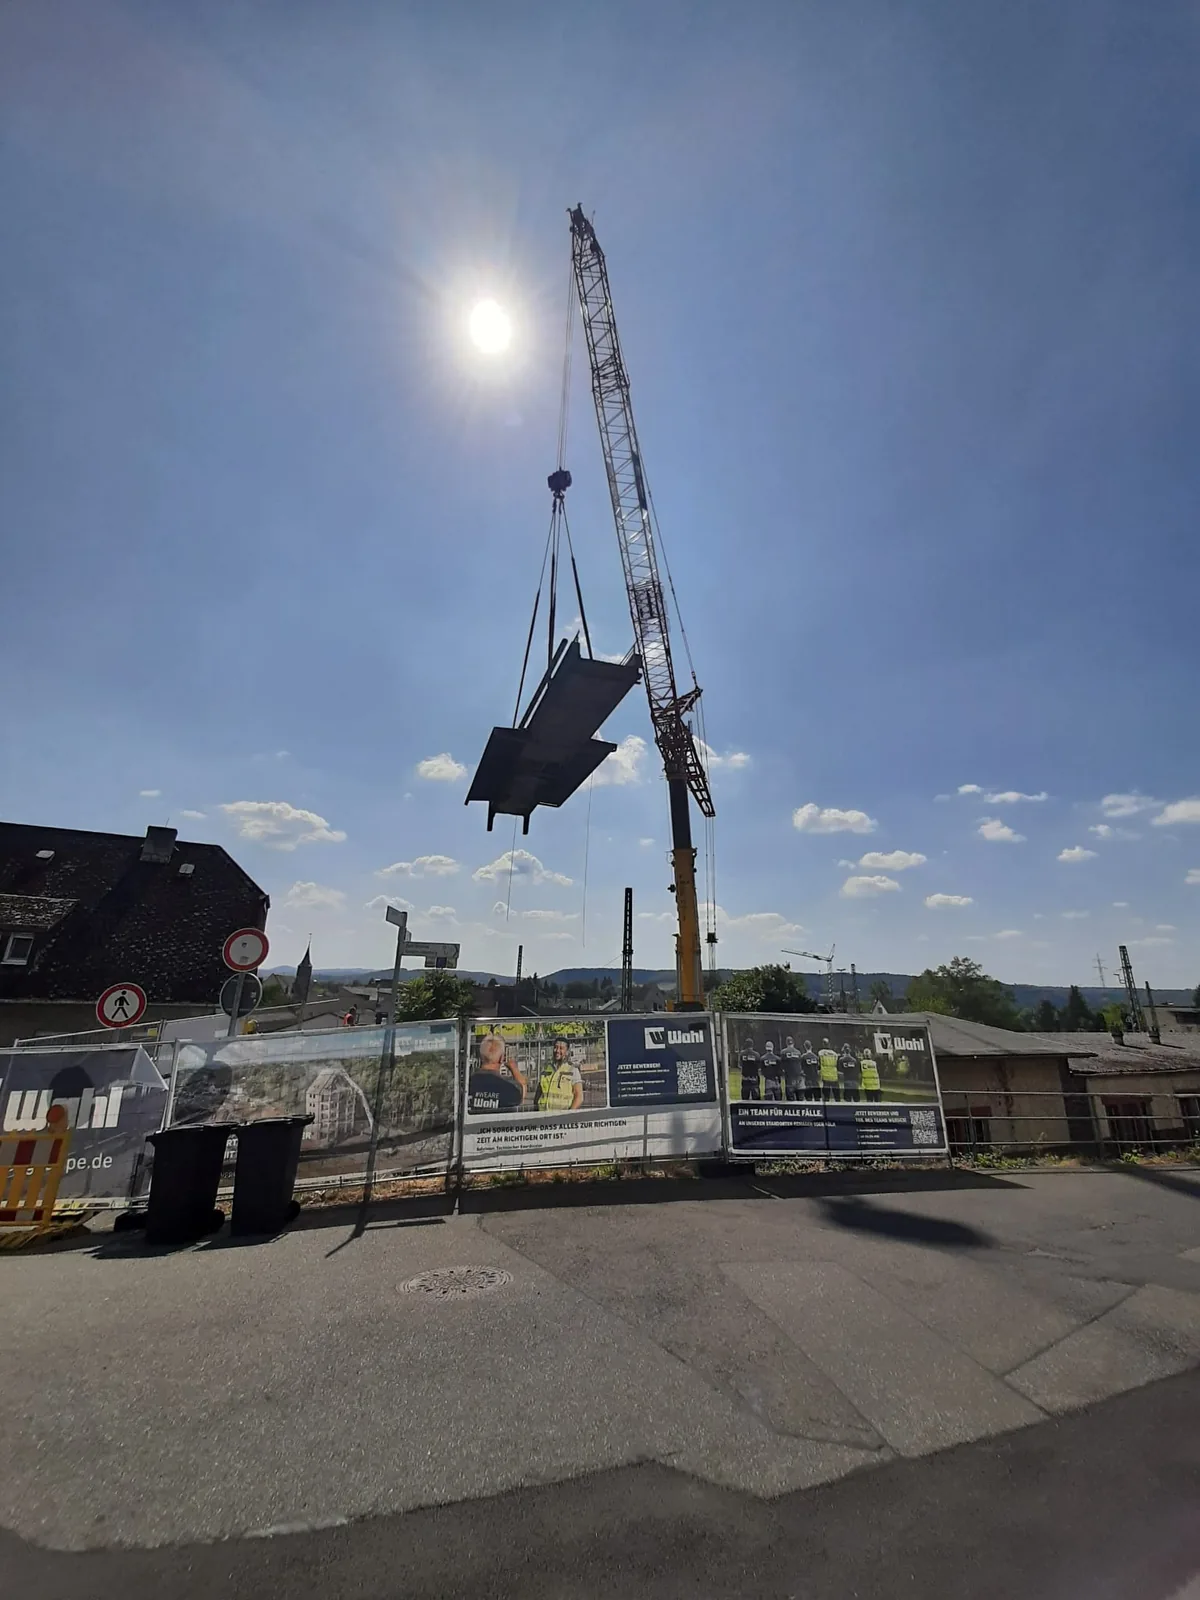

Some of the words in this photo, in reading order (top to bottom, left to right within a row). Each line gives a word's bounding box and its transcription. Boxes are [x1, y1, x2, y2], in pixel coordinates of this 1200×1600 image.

[667, 1029, 704, 1044] Wahl
[894, 1037, 925, 1051] Wahl
[473, 1097, 500, 1109] Wahl
[738, 1108, 749, 1116] EIN
[750, 1108, 769, 1117] TEAM
[769, 1107, 783, 1117] FÜR
[784, 1109, 801, 1117] ALLE
[801, 1108, 823, 1117] FÄLLE.
[492, 1126, 514, 1134] SORGE
[540, 1123, 557, 1131] DASS
[558, 1122, 579, 1130] ALLES
[580, 1121, 593, 1129] ZUR
[594, 1120, 627, 1128] RICHTIGEN
[476, 1136, 491, 1144] ZEIT
[492, 1135, 503, 1143] AM
[503, 1134, 538, 1142] RICHTIGEN
